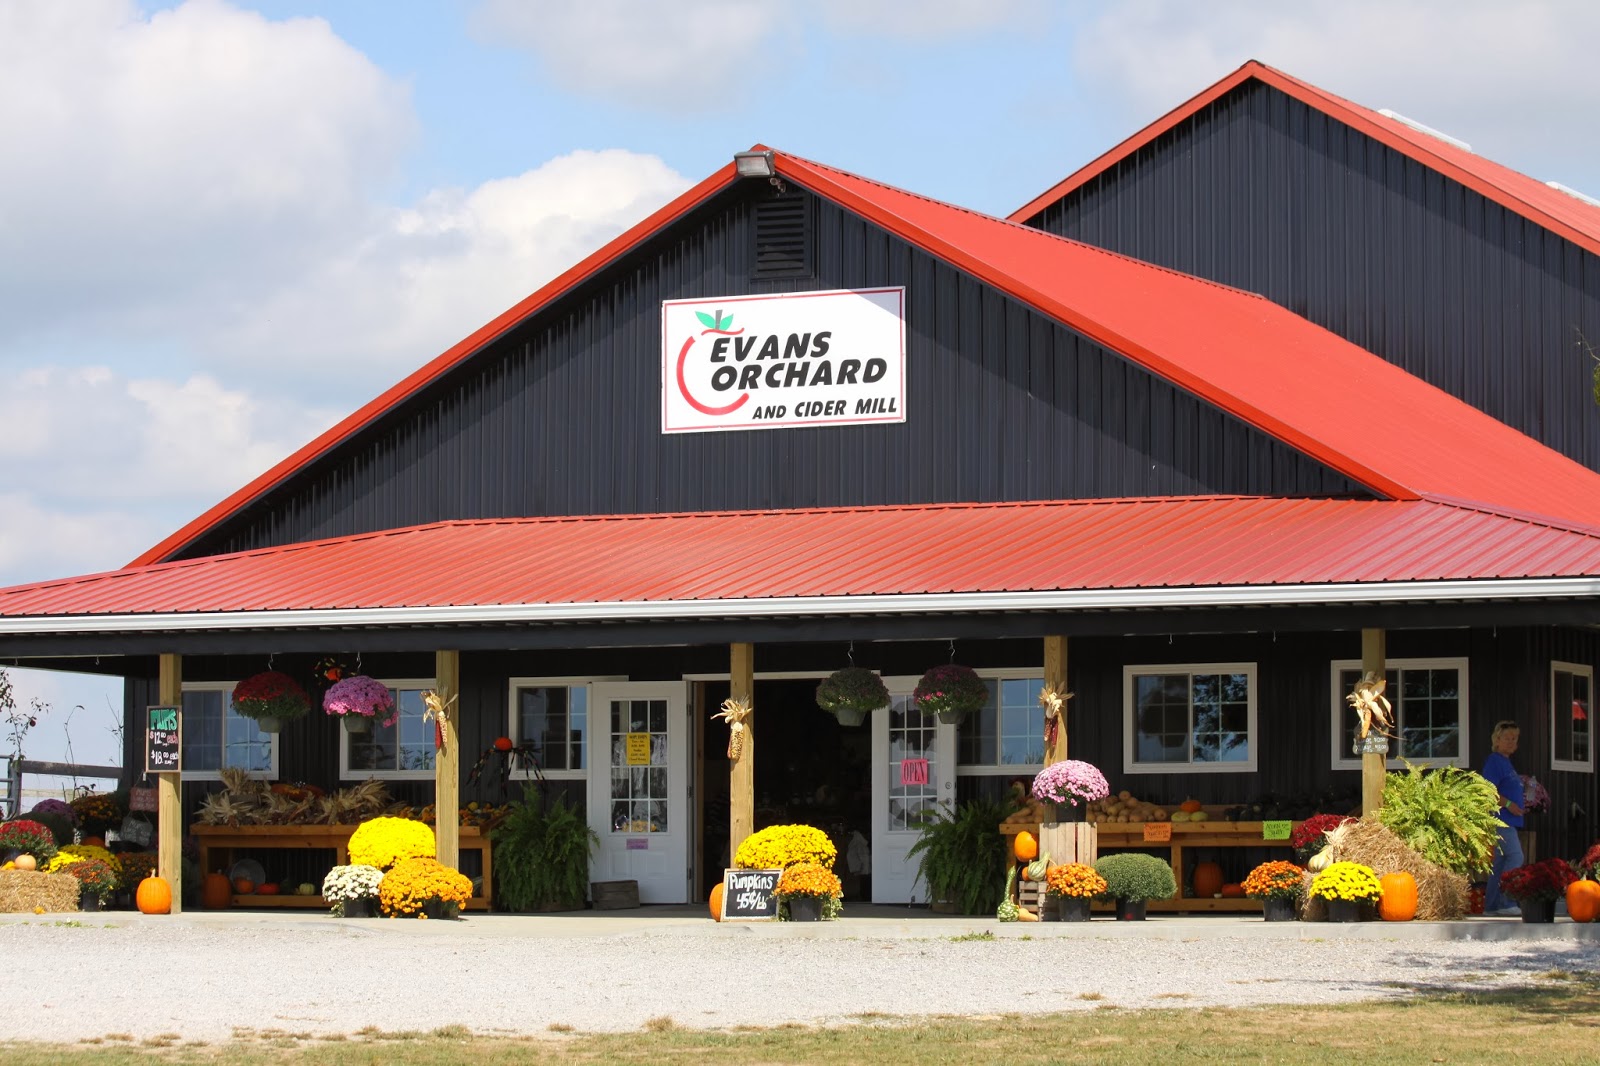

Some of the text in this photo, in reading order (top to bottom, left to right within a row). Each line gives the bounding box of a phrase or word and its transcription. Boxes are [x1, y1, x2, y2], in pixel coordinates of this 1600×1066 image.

[709, 331, 832, 363] EVANS
[710, 357, 888, 392] ORCHARD
[752, 397, 897, 420] AND CIDER MILL
[903, 761, 925, 782] OPEN
[729, 873, 773, 892] Pumpkins
